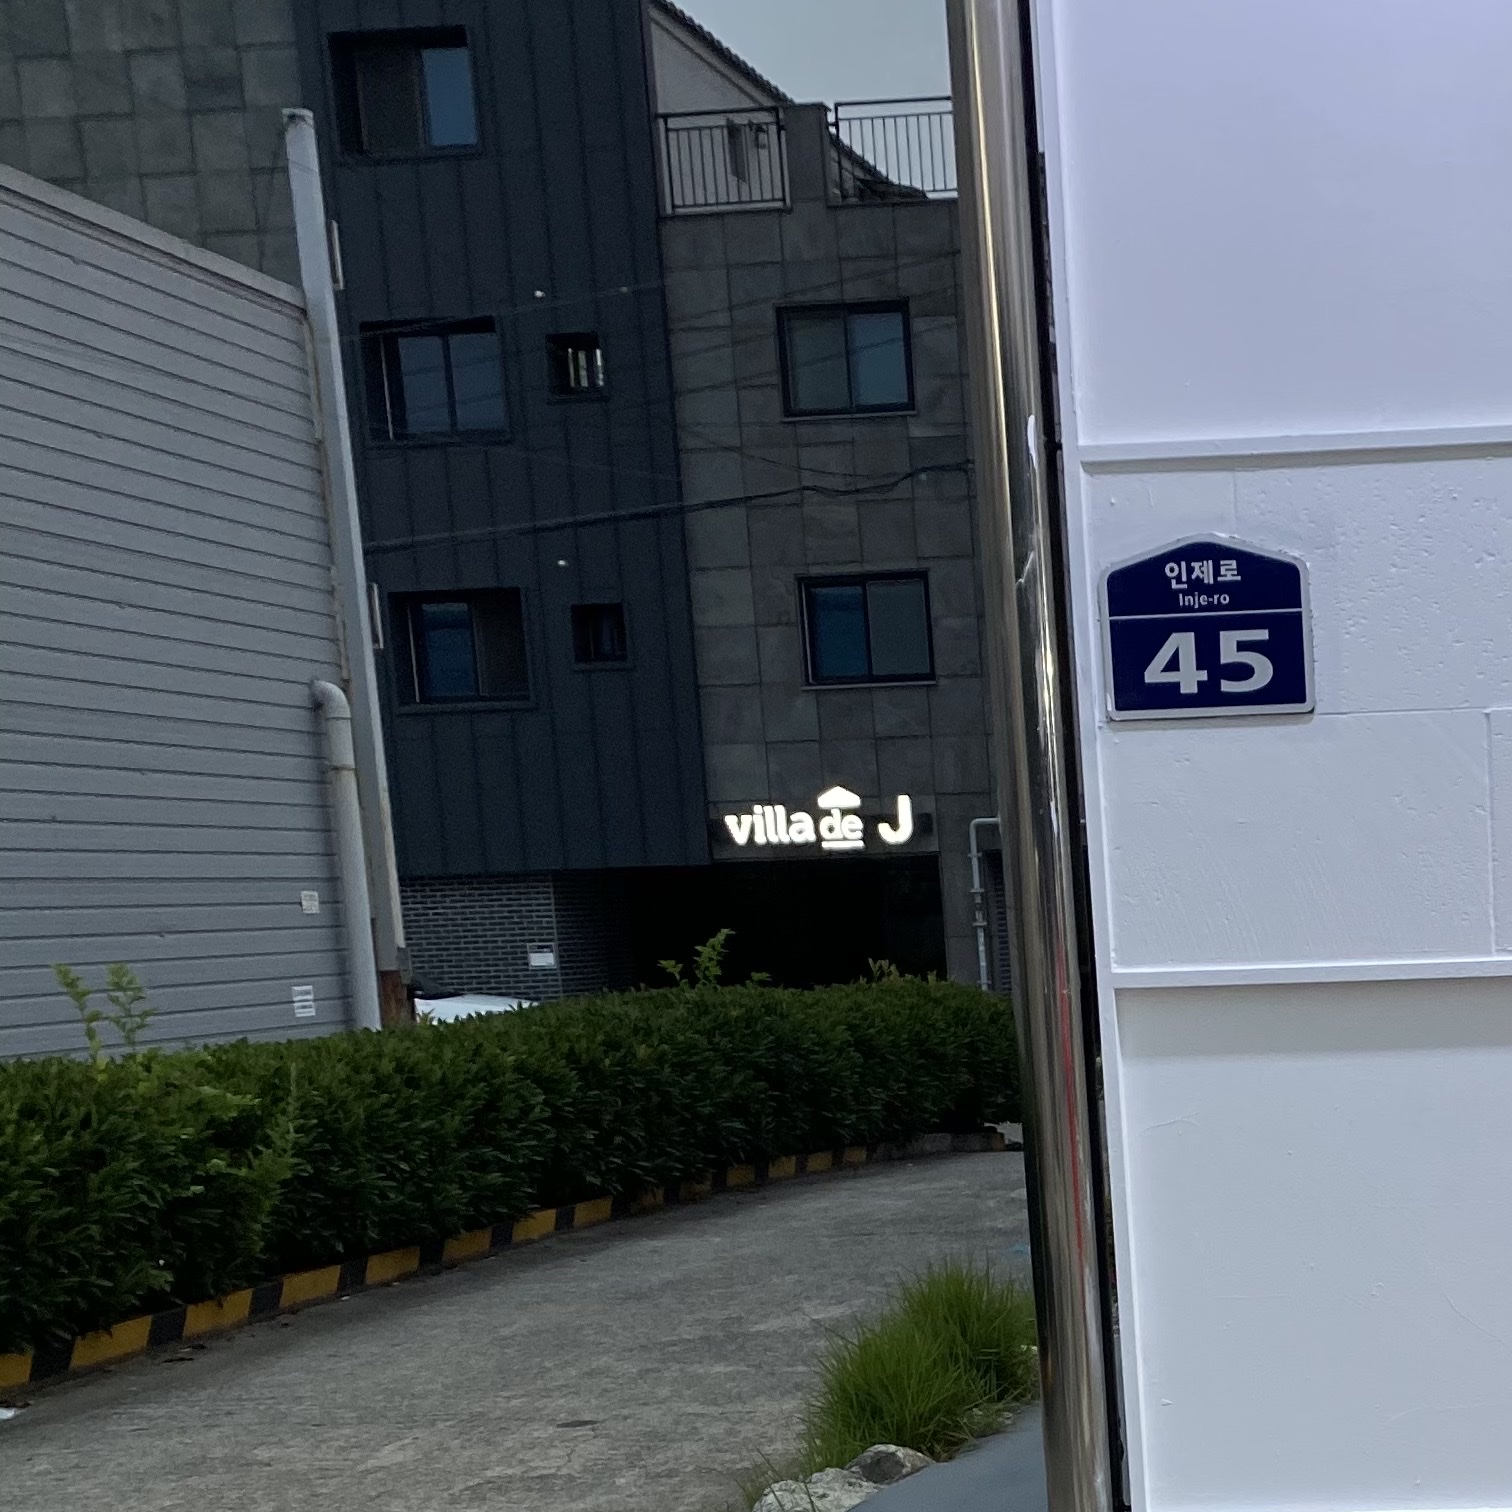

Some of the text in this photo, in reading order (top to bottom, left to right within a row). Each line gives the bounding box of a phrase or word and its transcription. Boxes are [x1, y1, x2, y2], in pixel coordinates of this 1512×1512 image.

[1164, 559, 1242, 590] 인제로
[1178, 591, 1230, 609] Inje-ro
[1143, 628, 1274, 694] 45
[724, 794, 915, 846] villa de J
